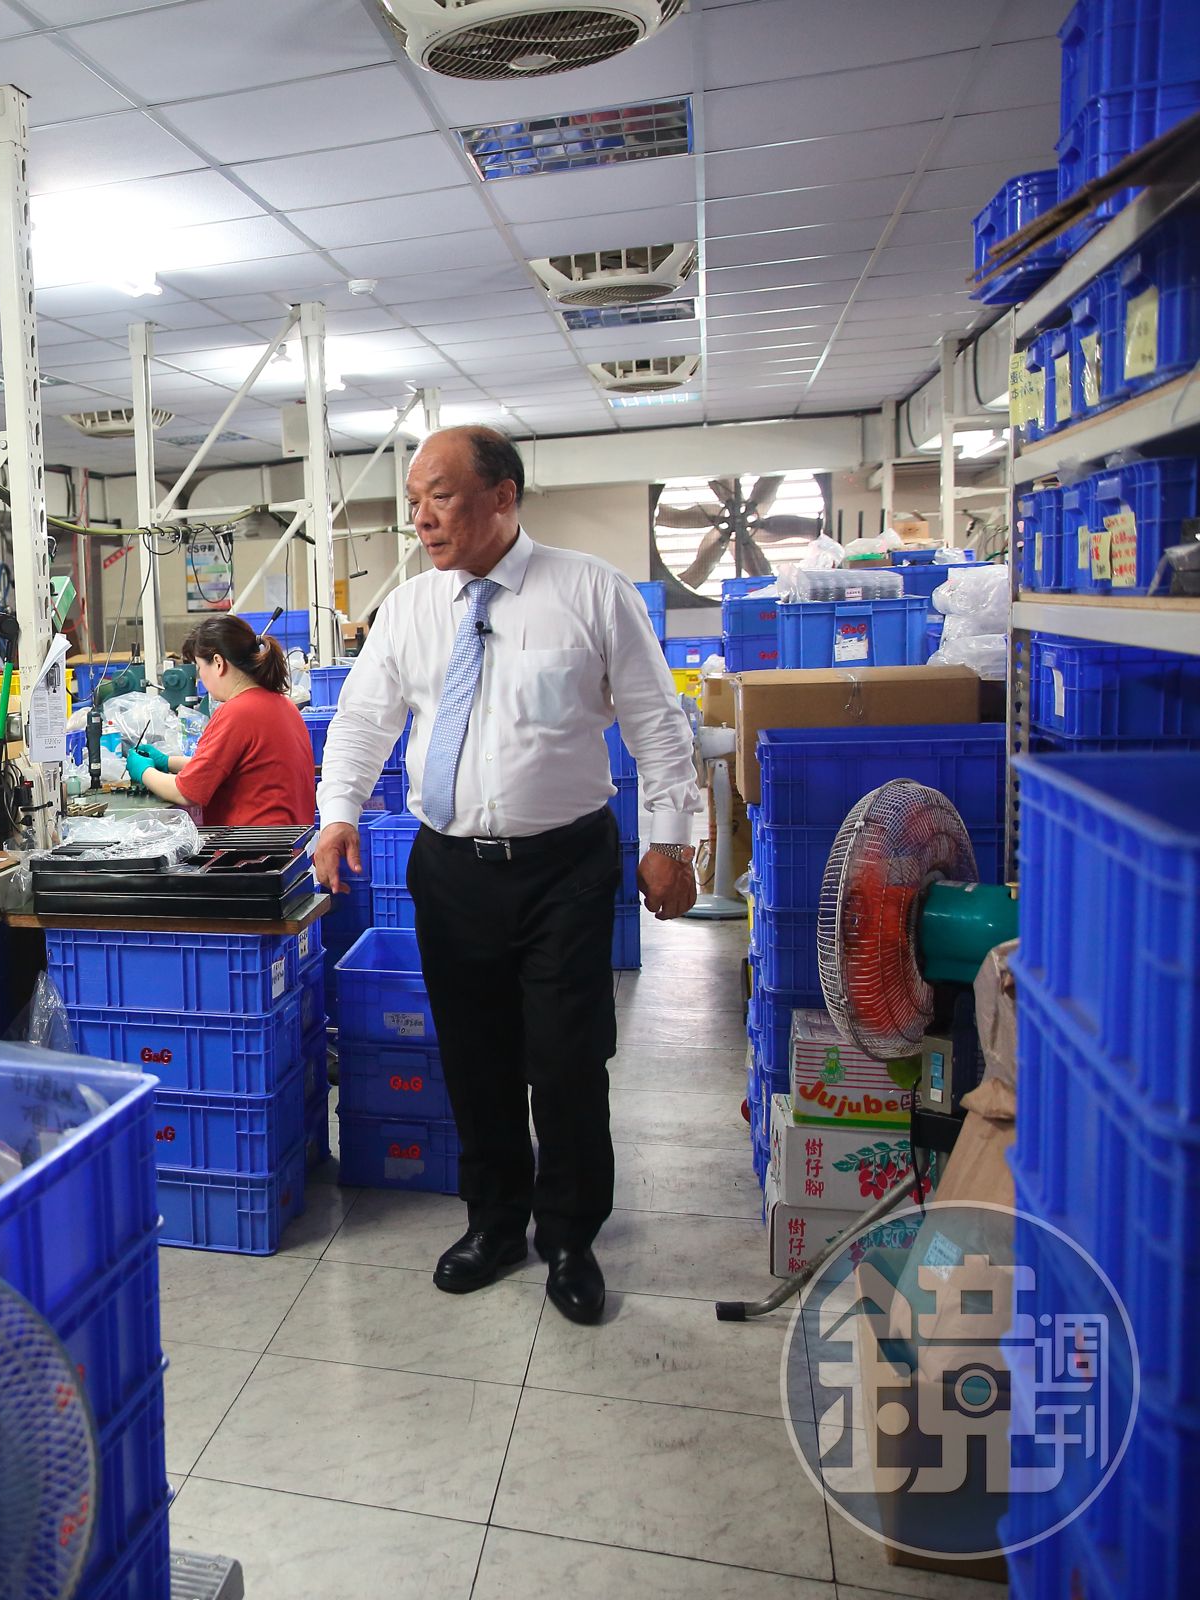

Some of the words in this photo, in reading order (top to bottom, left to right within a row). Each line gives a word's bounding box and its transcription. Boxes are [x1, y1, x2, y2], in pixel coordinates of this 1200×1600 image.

[141, 1047, 173, 1066] G&G
[799, 1080, 899, 1117] Jujube
[804, 1137, 825, 1199] 樹仔腳
